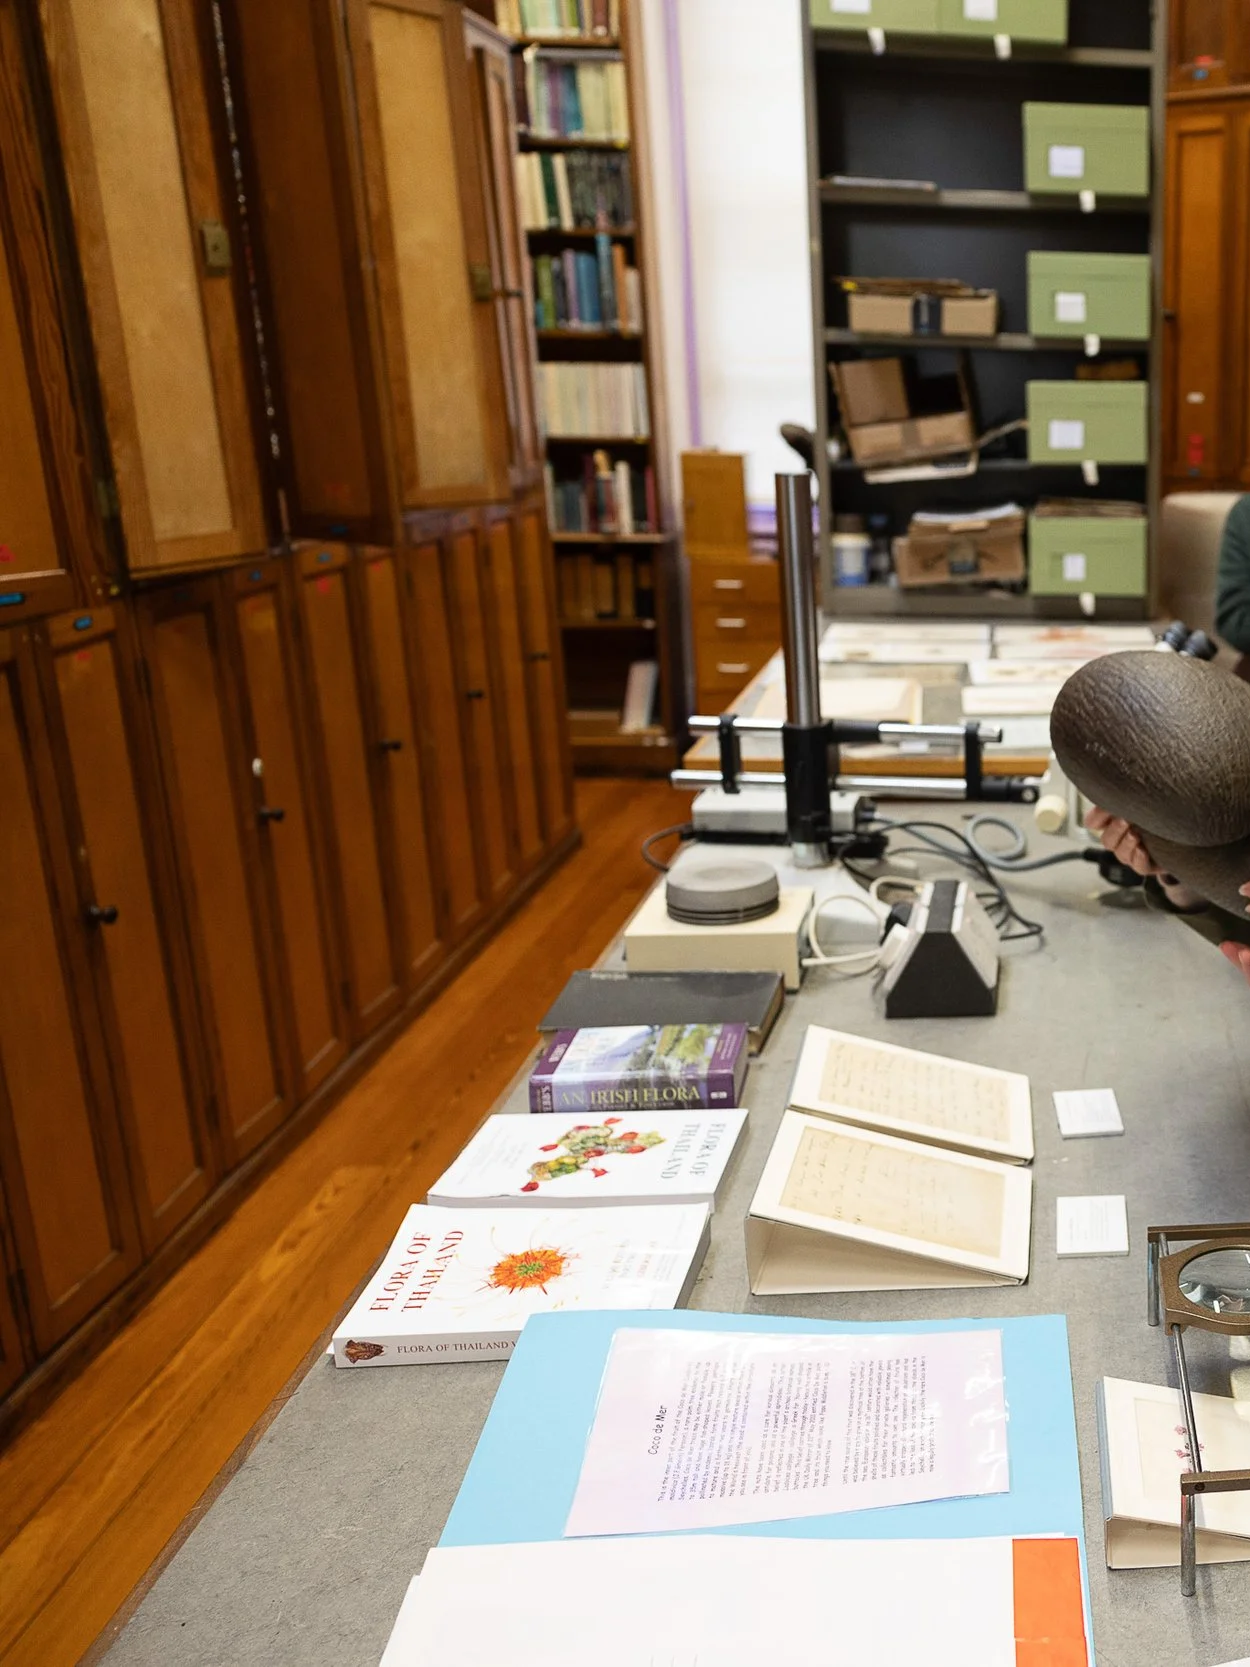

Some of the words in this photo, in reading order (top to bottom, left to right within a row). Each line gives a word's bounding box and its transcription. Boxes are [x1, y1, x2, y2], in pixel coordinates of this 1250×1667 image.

[560, 1092, 584, 1104] AN
[590, 1088, 637, 1104] IRISH
[643, 1086, 700, 1102] FLORA
[696, 1123, 726, 1158] FLORA
[660, 1123, 700, 1178] THAILAND
[689, 1162, 708, 1175] OF
[369, 1260, 420, 1312] FLORA
[406, 1232, 430, 1254] OF
[400, 1230, 464, 1312] THAILAND
[397, 1345, 433, 1353] FLORA
[436, 1344, 450, 1352] OF
[453, 1342, 508, 1351] THAILAND
[655, 1405, 667, 1422] Mer
[652, 1424, 664, 1434] de
[648, 1436, 658, 1455] Coco
